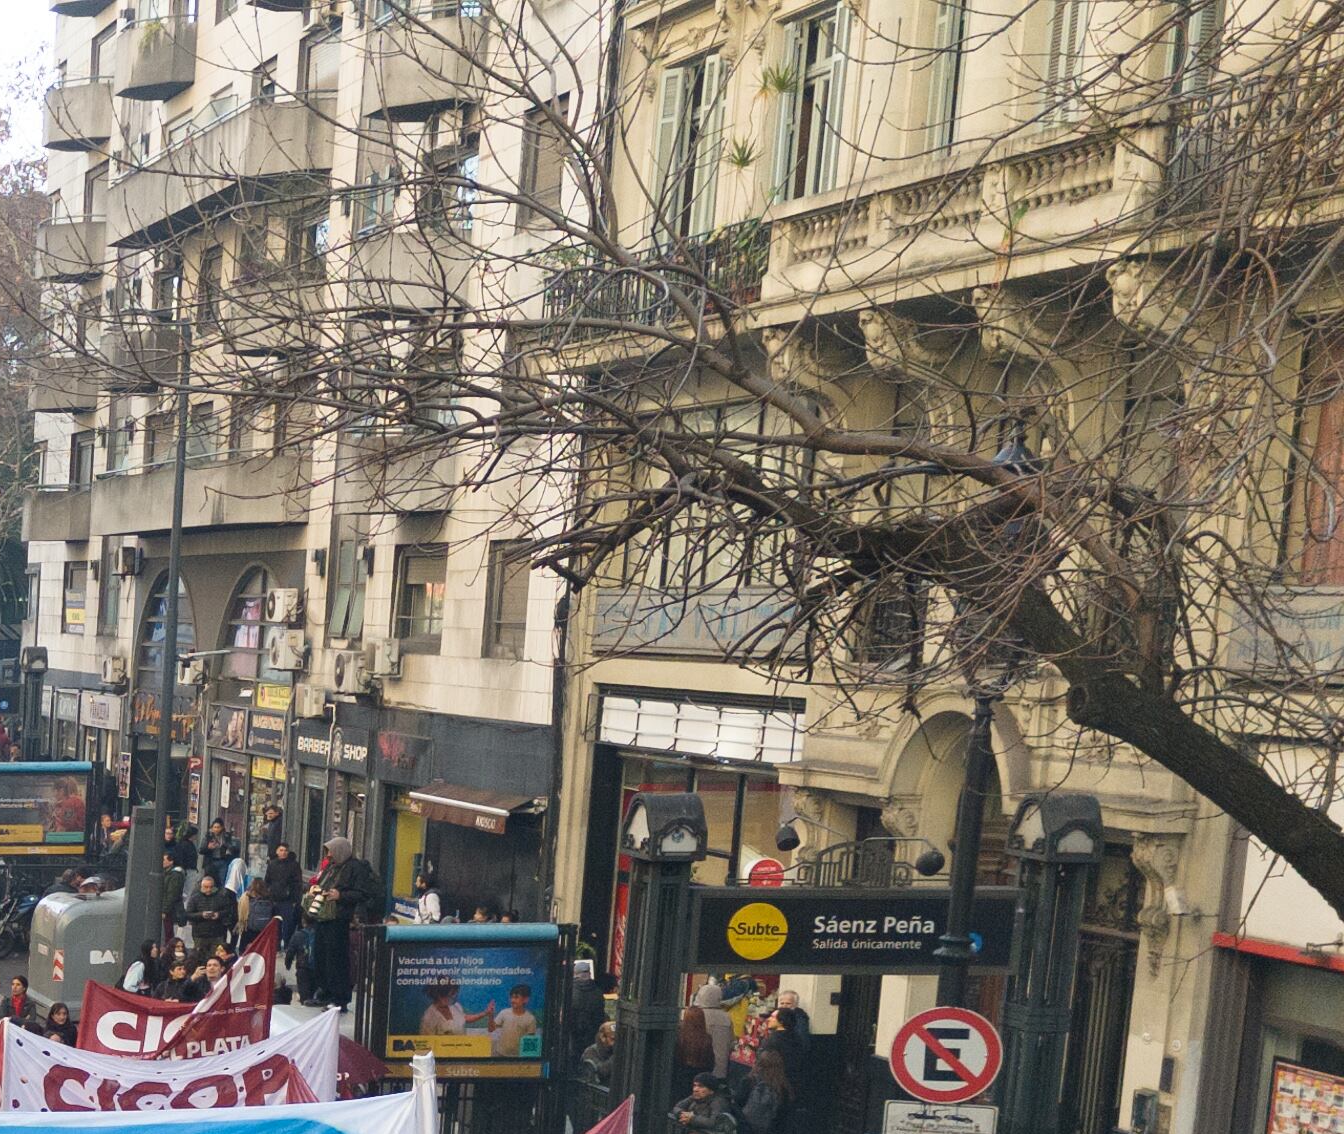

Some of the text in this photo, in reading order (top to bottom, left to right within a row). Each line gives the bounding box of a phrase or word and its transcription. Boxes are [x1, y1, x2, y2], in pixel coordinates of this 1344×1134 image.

[297, 735, 330, 754] BARBER
[343, 745, 368, 761] SHOP
[737, 921, 780, 935] Subte
[813, 915, 935, 934] Sáenz Peña
[812, 938, 922, 950] Salida únicamente
[398, 955, 434, 966] Vacuná
[443, 956, 459, 966] tus
[460, 955, 484, 967] hijos
[397, 967, 418, 978] para
[419, 966, 462, 978] prevenir
[396, 976, 438, 986] consultá
[450, 976, 502, 986] calendario
[185, 1035, 250, 1059] PLATA
[392, 1039, 415, 1052] BA
[923, 1027, 970, 1081] E
[445, 1065, 480, 1077] Subte
[43, 1053, 291, 1112] CICOP
